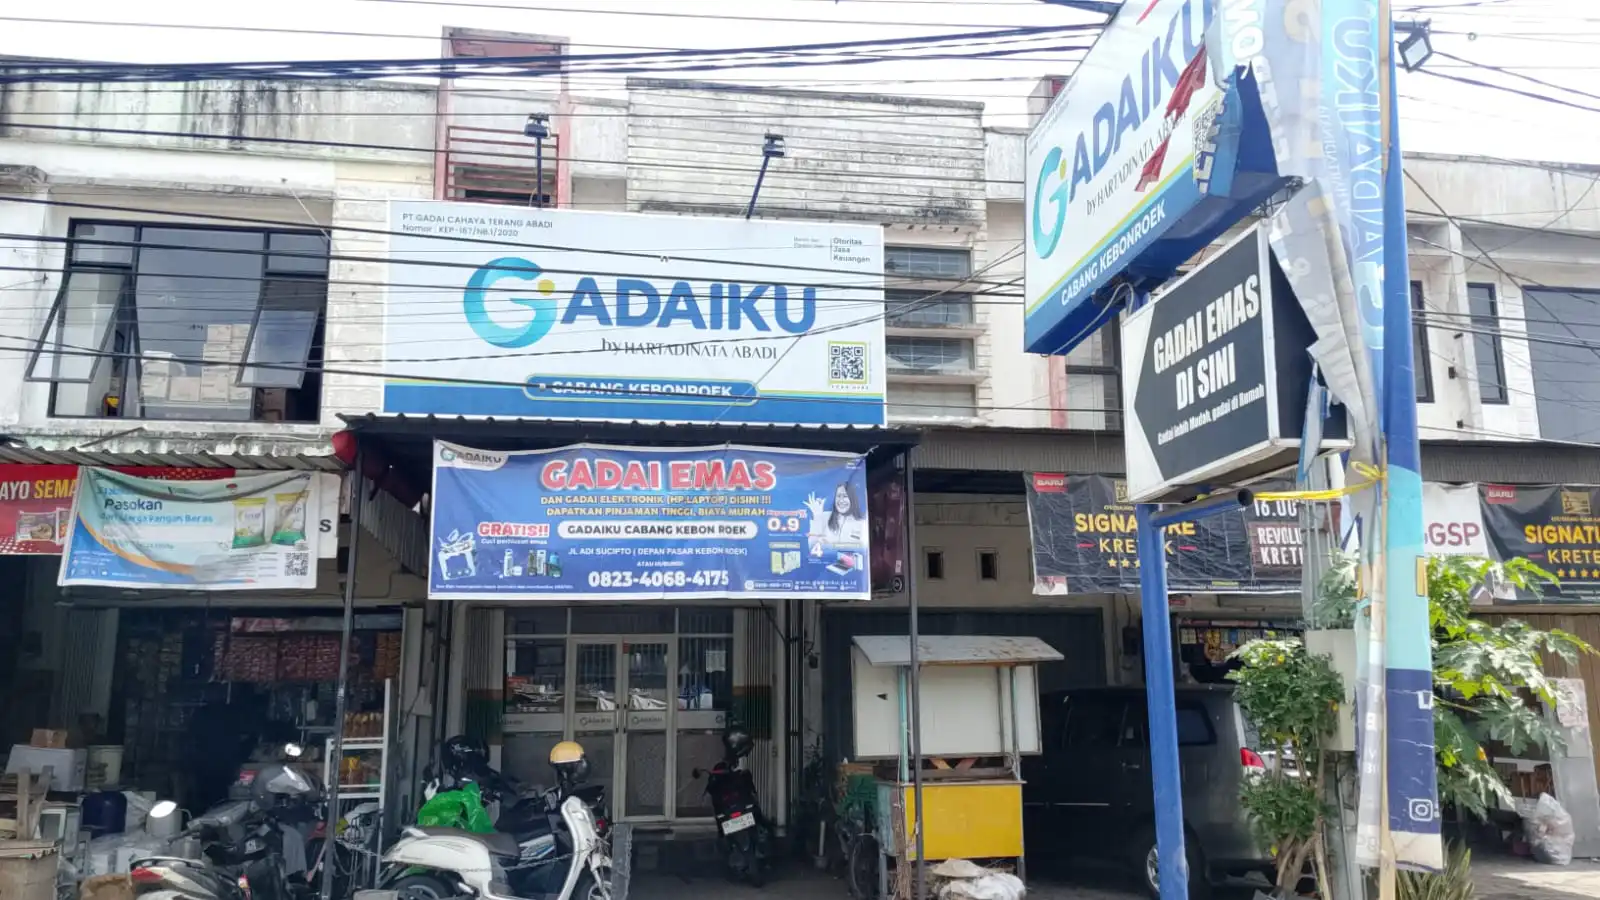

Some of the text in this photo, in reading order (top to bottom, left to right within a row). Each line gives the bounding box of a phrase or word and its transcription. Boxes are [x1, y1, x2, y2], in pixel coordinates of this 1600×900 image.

[1033, 0, 1214, 260] GADAIKU
[402, 213, 553, 229] PT GADAI CAHAYA TERANG ABADI
[402, 223, 432, 232] Nomor
[833, 236, 862, 246] Otoritas
[833, 254, 871, 264] Keuangan
[1061, 200, 1166, 306] CABANG KEBONROEK
[463, 257, 816, 349] GADAIKU
[1153, 310, 1204, 375] GADAI
[1206, 274, 1260, 343] EMAS
[601, 337, 777, 360] by HARTADINATA ABADI
[1175, 365, 1195, 410] DI
[1197, 342, 1237, 399] SINI
[551, 380, 625, 396] CABANG
[1231, 394, 1239, 411] di
[1239, 382, 1265, 408] Rumah
[540, 457, 777, 491] GADAI EMAS
[0, 480, 31, 500] AYO
[1488, 490, 1514, 499] BARU
[104, 498, 163, 511] Pasokan
[540, 496, 563, 505] DAN
[565, 495, 598, 504] GADAI
[599, 495, 664, 504] ELEKTRONIK
[730, 495, 760, 504] DISINI
[546, 507, 603, 516] DAPATKAN
[604, 507, 659, 516] PINJAMAN
[698, 507, 726, 516] BIAYA
[728, 507, 765, 516] MURAH
[478, 522, 550, 537] GRATIS!!
[567, 524, 747, 535] GADAIKU CABANG KEBON ROEK
[637, 547, 665, 556] DEPAN
[666, 547, 694, 555] PASAR
[695, 546, 724, 555] KEBON
[587, 570, 729, 588] 0823-4068-4175
